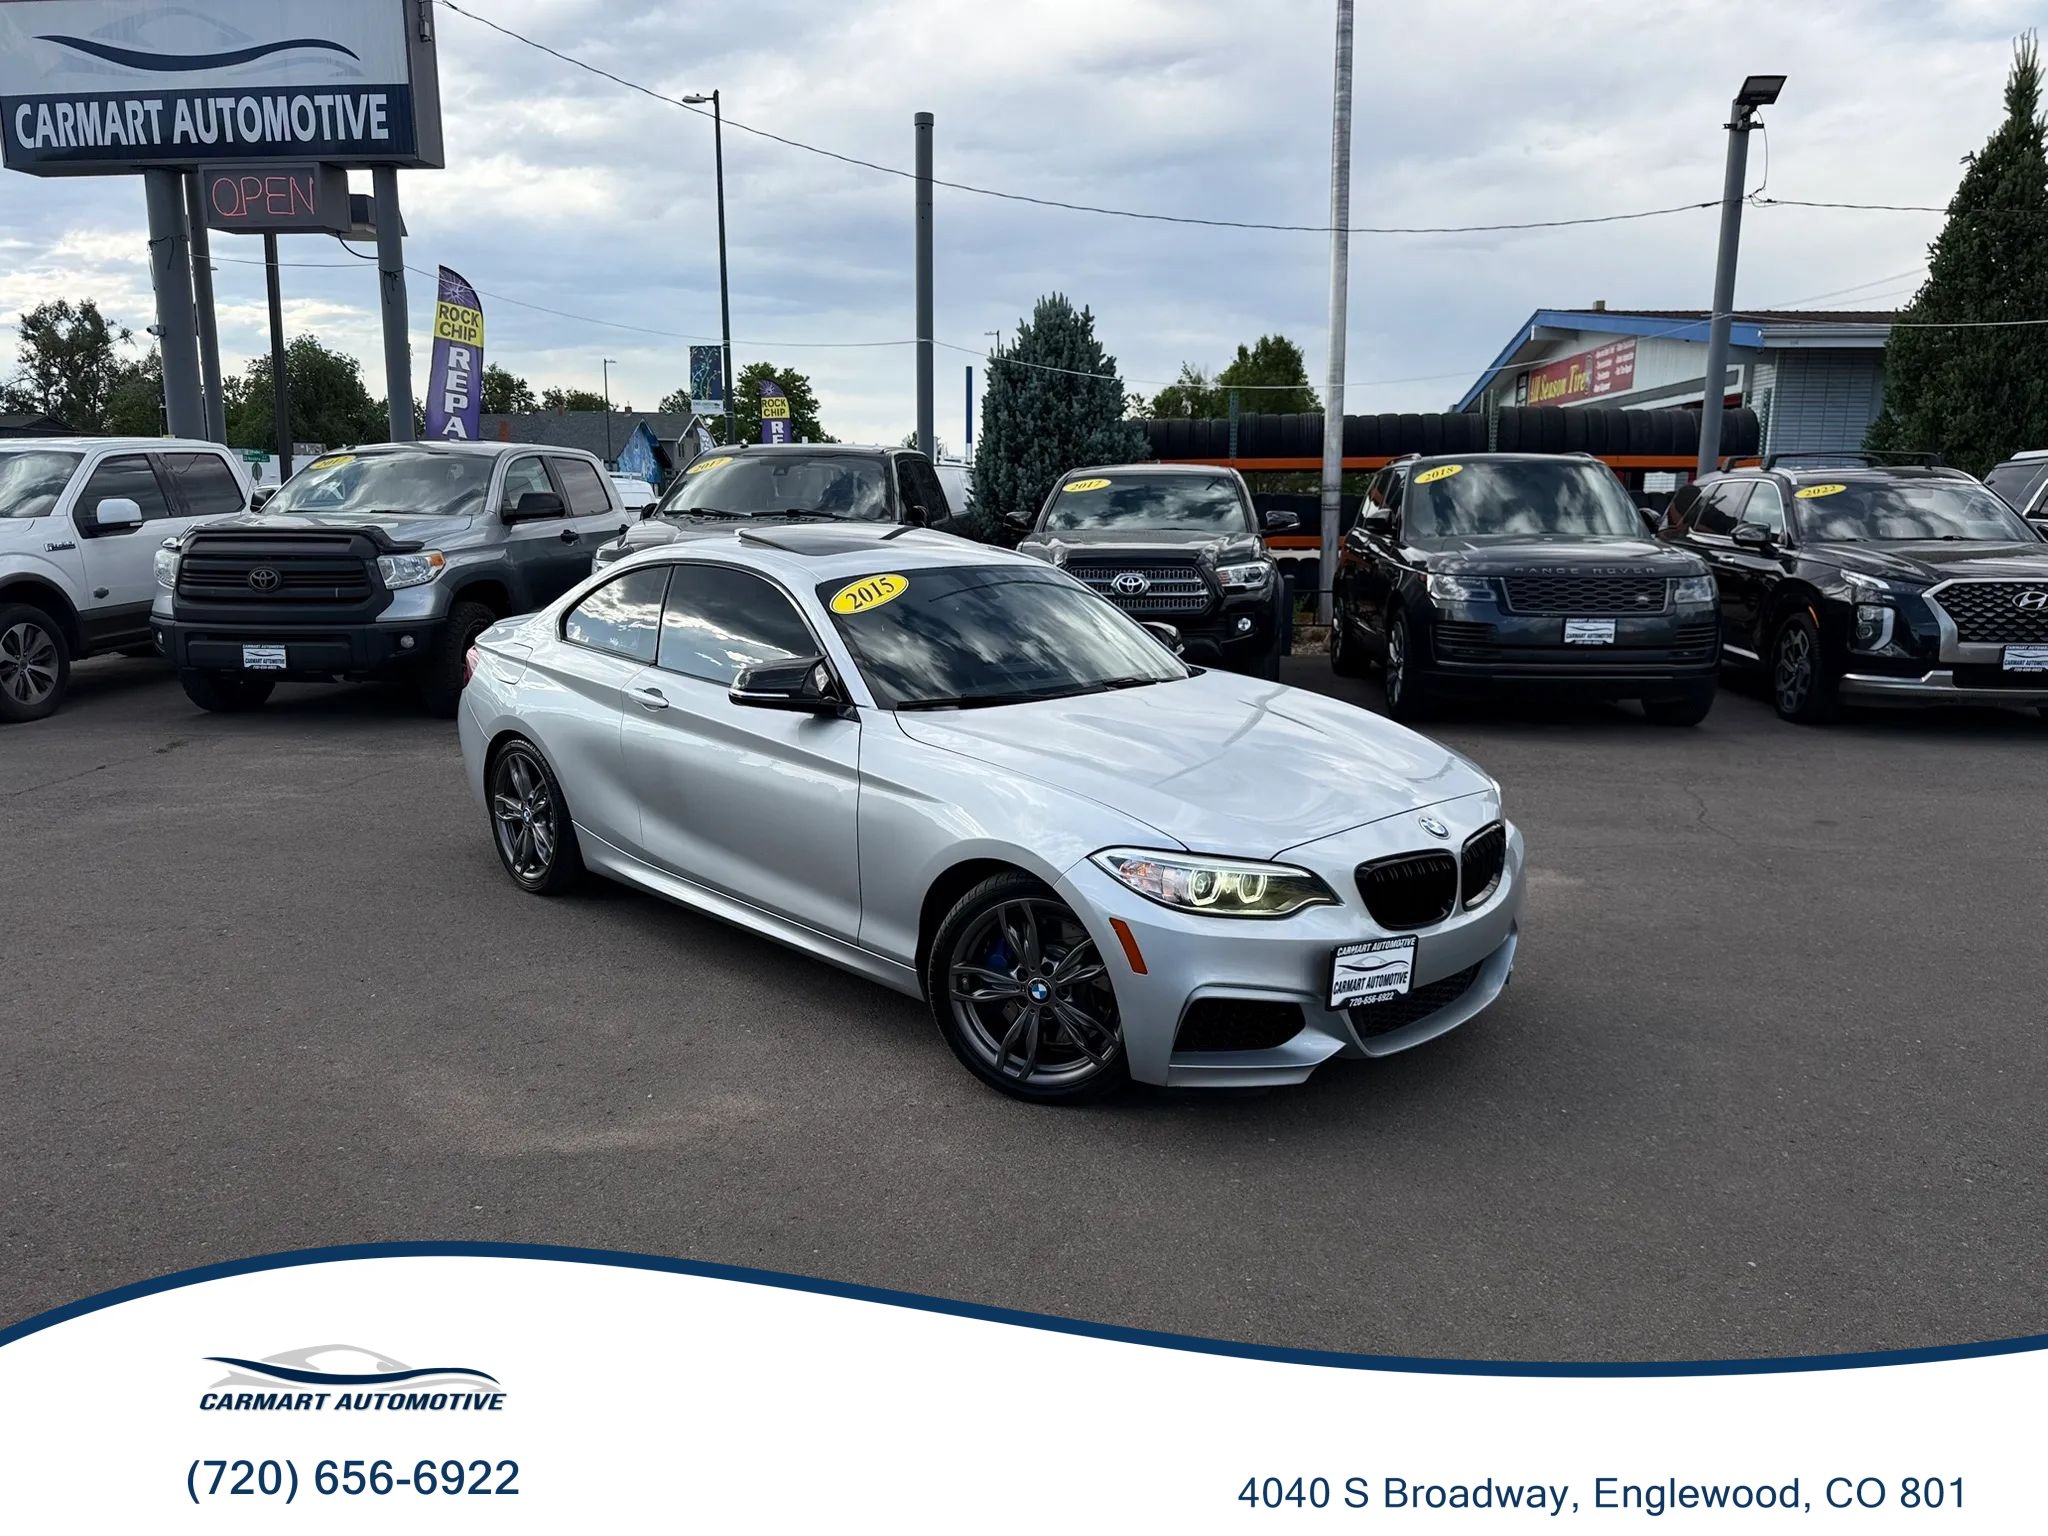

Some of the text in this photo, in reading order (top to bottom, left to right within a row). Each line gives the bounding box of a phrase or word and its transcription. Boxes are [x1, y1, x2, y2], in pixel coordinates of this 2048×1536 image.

[15, 94, 390, 149] CARMART AUTOMOTIVE
[212, 176, 315, 216] OPEN
[439, 304, 479, 328] ROCK
[439, 322, 477, 341] CHIP
[442, 347, 470, 441] REPA
[1540, 374, 1567, 401] Season
[762, 399, 787, 408] ROCK
[763, 408, 786, 417] CHIP
[1425, 466, 1455, 481] 2018
[1806, 485, 1837, 496] 2022
[1514, 567, 1580, 575] RANGE
[845, 577, 895, 609] 2015
[1337, 937, 1417, 956] CARMART AUTOMOTIVE
[1333, 971, 1409, 995] CARMART AUTOMOTIVE
[1348, 991, 1394, 1007] 720-656-6922
